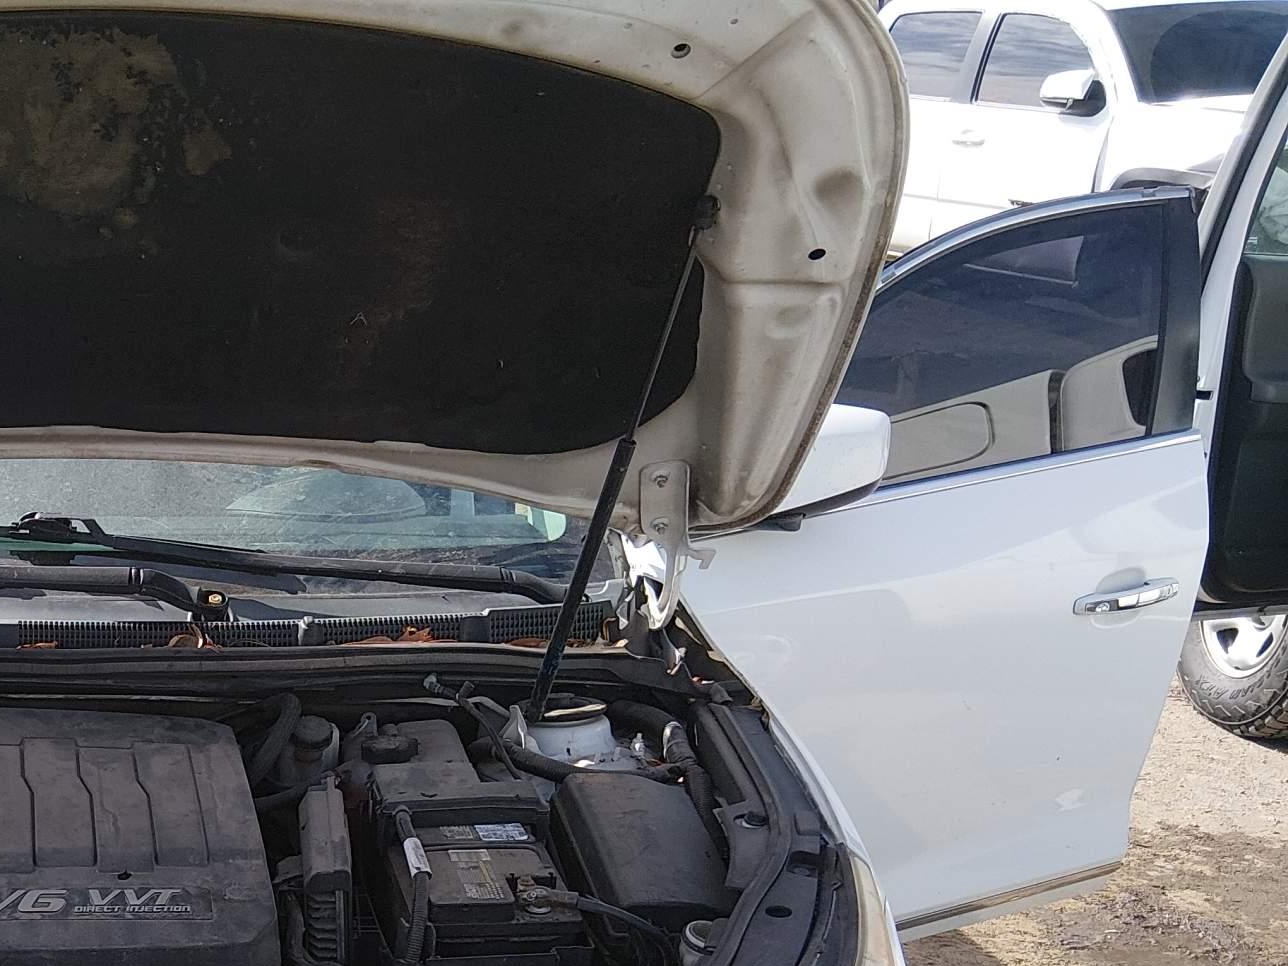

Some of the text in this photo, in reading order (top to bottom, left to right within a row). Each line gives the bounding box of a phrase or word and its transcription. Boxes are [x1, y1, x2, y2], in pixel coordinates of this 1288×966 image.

[88, 888, 184, 905] VVT
[73, 905, 191, 913] DIRECT INJECTION
